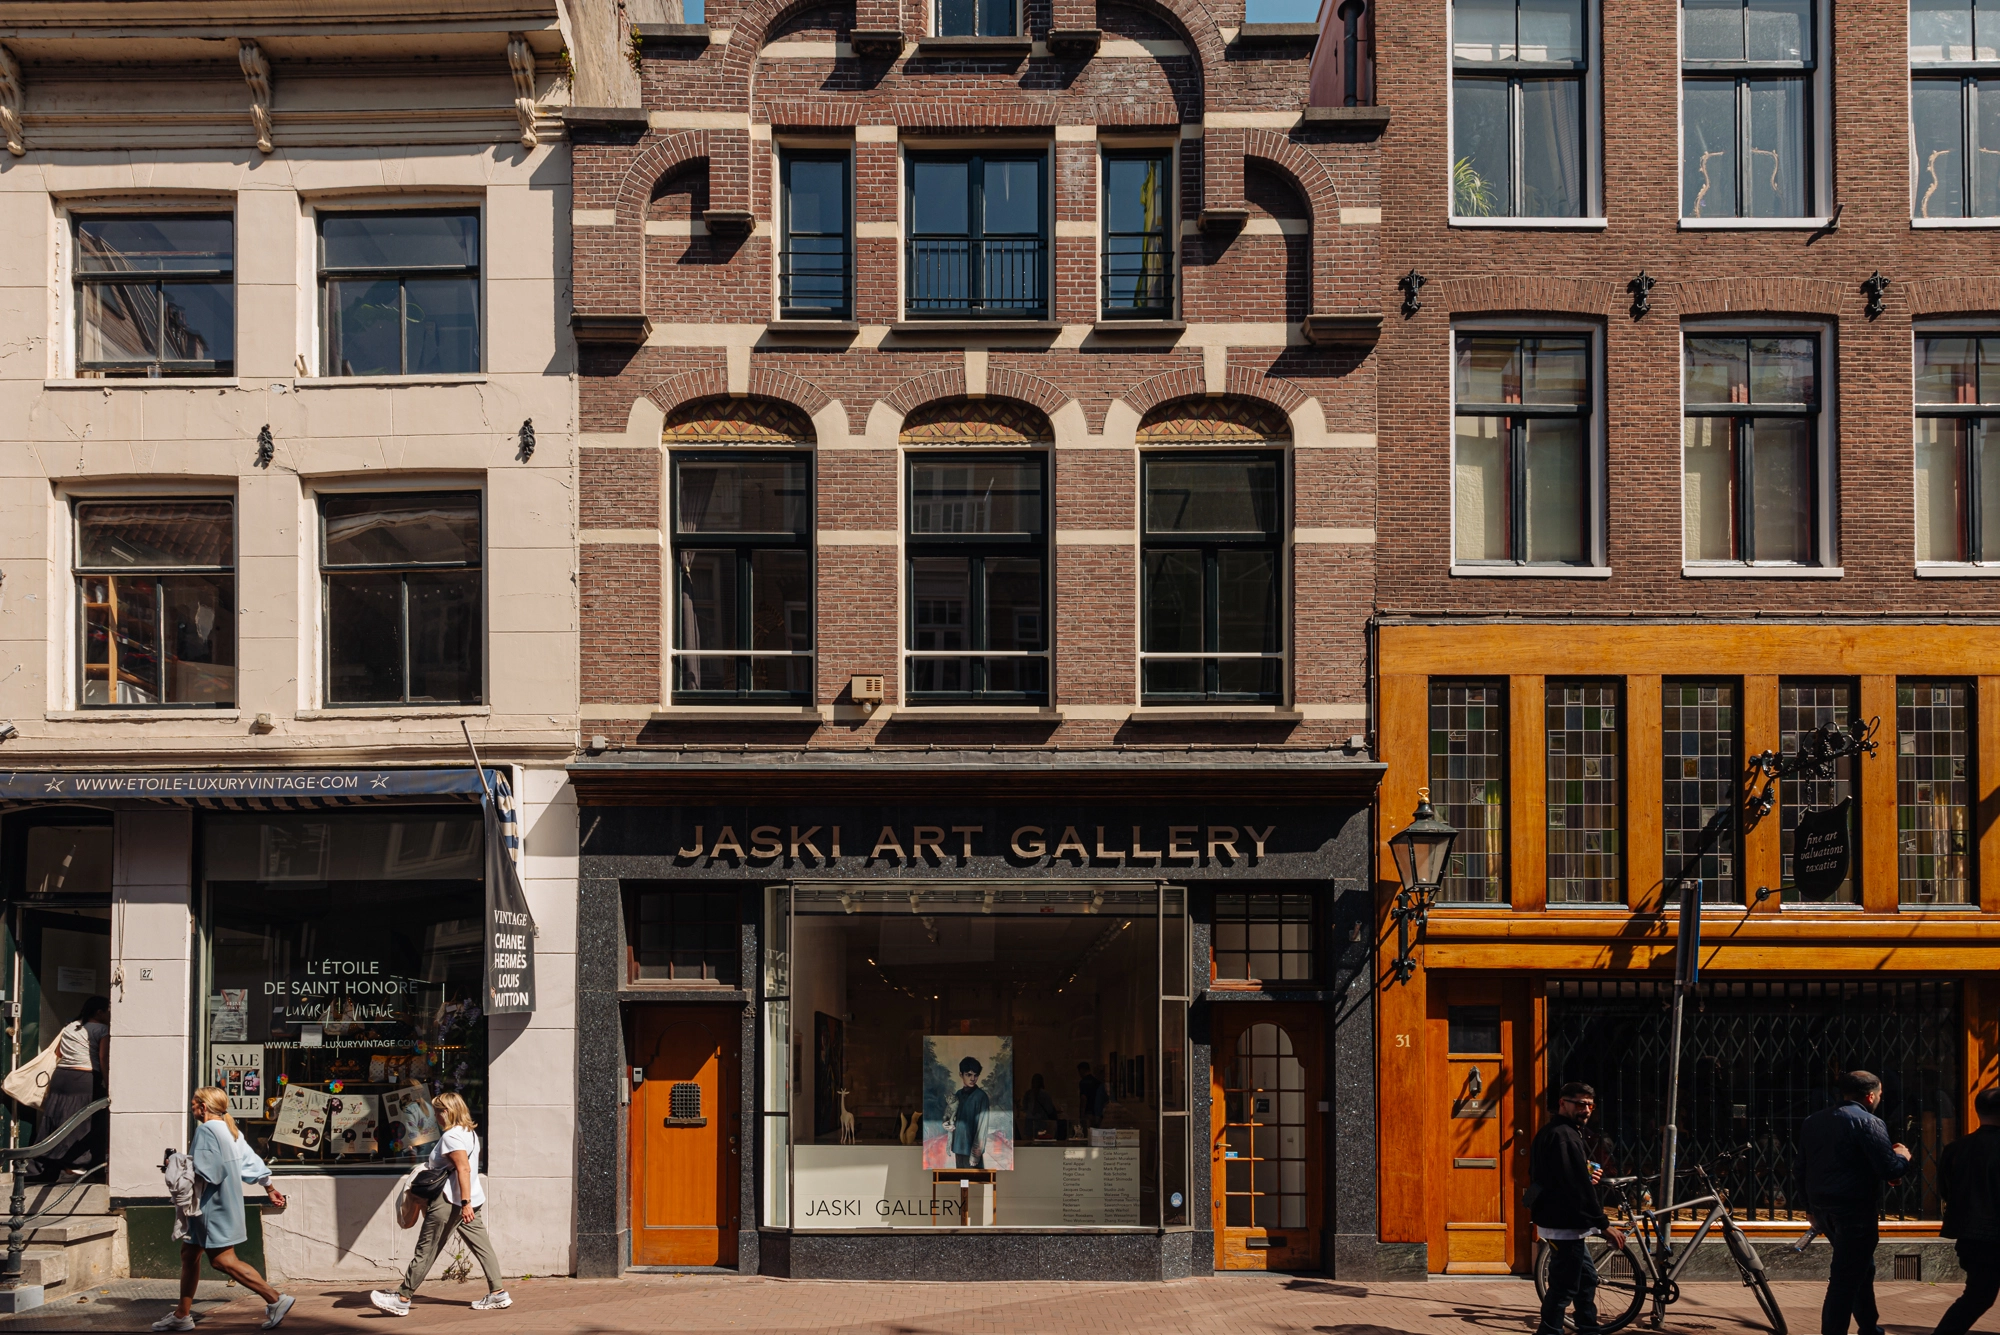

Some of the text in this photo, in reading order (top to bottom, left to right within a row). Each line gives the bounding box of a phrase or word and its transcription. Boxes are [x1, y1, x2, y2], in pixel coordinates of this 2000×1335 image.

[678, 825, 1277, 858] JASKI ART GALLERY
[1804, 831, 1838, 850] fine art
[1800, 844, 1844, 860] valuations
[1805, 858, 1838, 873] taxaties
[493, 909, 528, 927] VINTAGE
[494, 932, 527, 950] CHANEL
[494, 950, 528, 969] HERMÈS
[142, 969, 152, 978] 27
[498, 973, 520, 988] LOUIS
[264, 981, 286, 995] DE
[291, 981, 340, 995] SAINT
[494, 991, 529, 1007] VUITTON
[285, 1002, 394, 1028] LUXURY VINTAGE
[1395, 1034, 1411, 1048] 31
[216, 1053, 260, 1067] SALE
[229, 1097, 260, 1110] ALE
[805, 1199, 967, 1217] JASKI GALLERY
